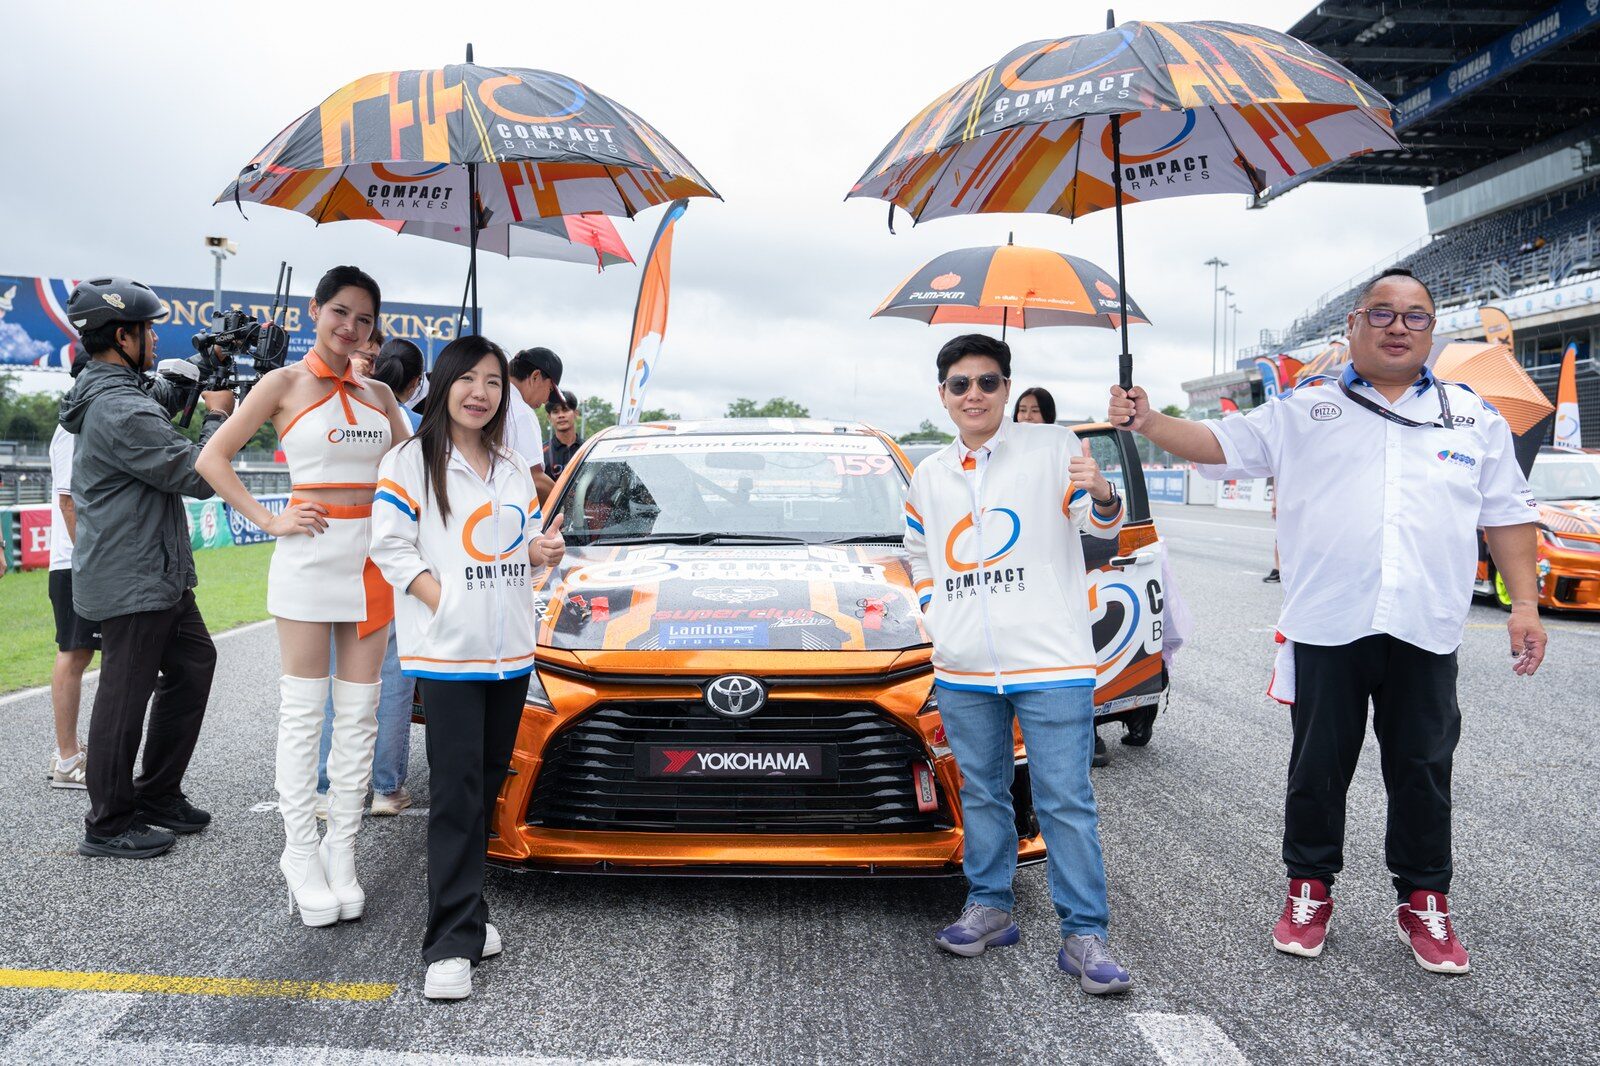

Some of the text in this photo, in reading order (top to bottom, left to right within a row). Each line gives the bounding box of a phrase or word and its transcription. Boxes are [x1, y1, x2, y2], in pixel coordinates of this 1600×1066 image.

[1521, 12, 1561, 48] YAMAHA
[1457, 51, 1492, 86] YAMAHA
[995, 72, 1134, 113] COMPACT
[993, 89, 1130, 123] BRAKES
[496, 123, 615, 144] COMPACT
[503, 140, 619, 154] BRAKES
[1131, 170, 1210, 190] RAKES
[367, 184, 453, 200] COMPACT
[366, 199, 449, 210] BRAKES
[909, 291, 965, 300] PUMPKIN
[230, 303, 302, 332] IVE
[380, 313, 455, 341] KING
[1315, 407, 1337, 417] PIZZA
[346, 430, 383, 438] COMPACT
[827, 454, 894, 477] 159
[465, 563, 526, 580] COMPACT
[945, 567, 1025, 592] COMPACT
[467, 578, 525, 590] BRAKES
[947, 582, 1026, 602] BRAKES
[669, 624, 733, 636] Lamina
[697, 752, 810, 770] YOKOHAMA
